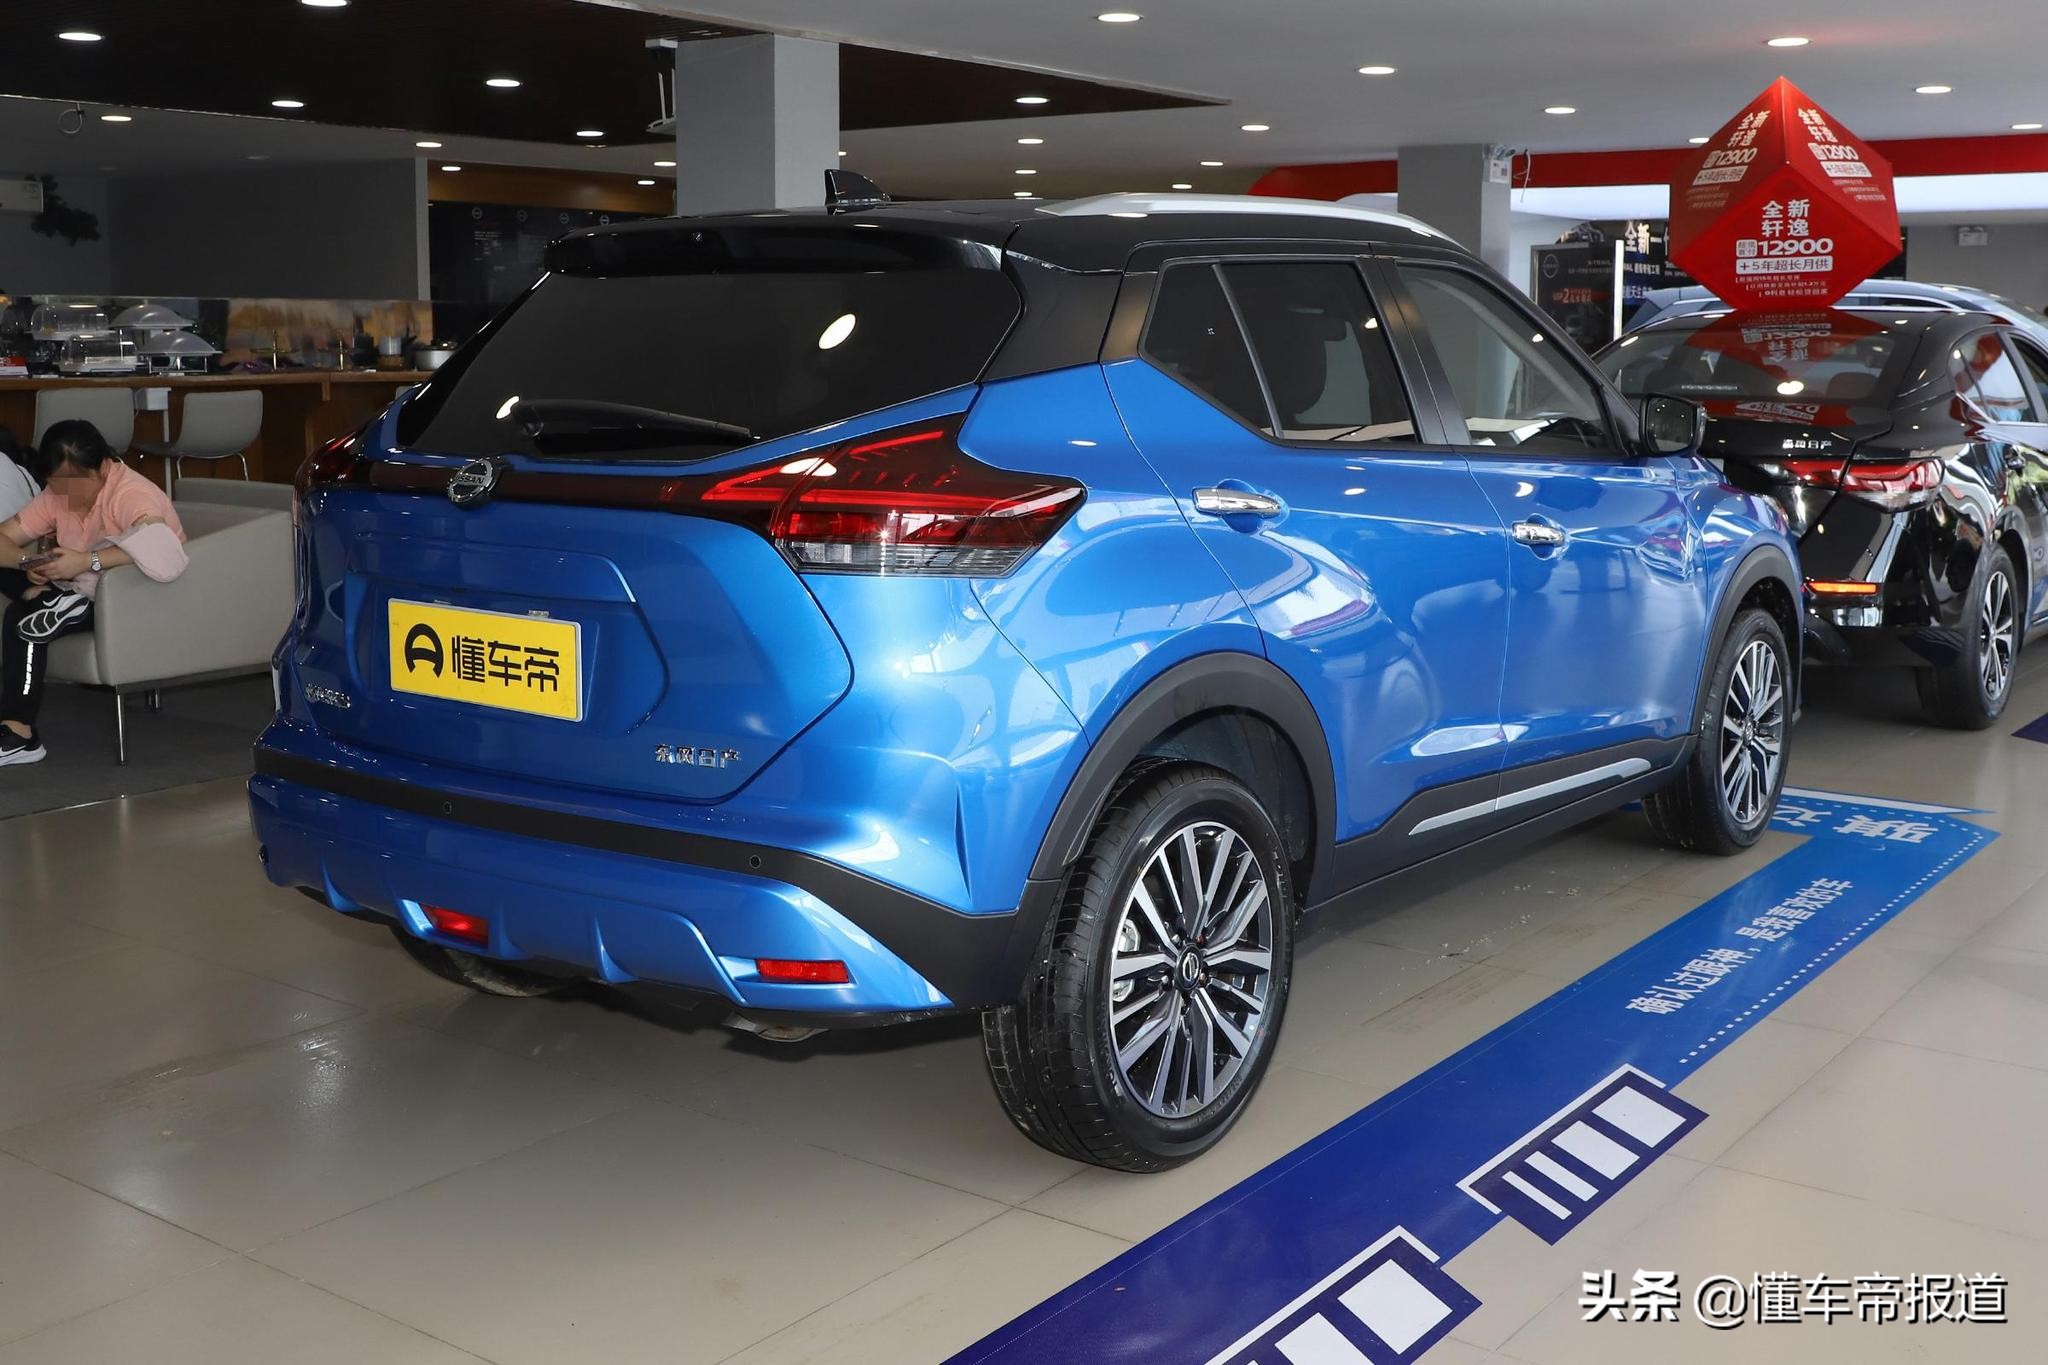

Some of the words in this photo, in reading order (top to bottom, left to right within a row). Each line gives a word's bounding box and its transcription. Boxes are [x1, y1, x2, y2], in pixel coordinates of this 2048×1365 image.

[1715, 147, 1758, 166] 12900
[1762, 199, 1810, 219] 全新
[1761, 219, 1809, 238] 轩逸
[1758, 238, 1834, 256] 12900
[1740, 258, 1830, 272] +5年超长月供
[452, 635, 560, 693] 懂车帝
[655, 744, 741, 768] 东风日产
